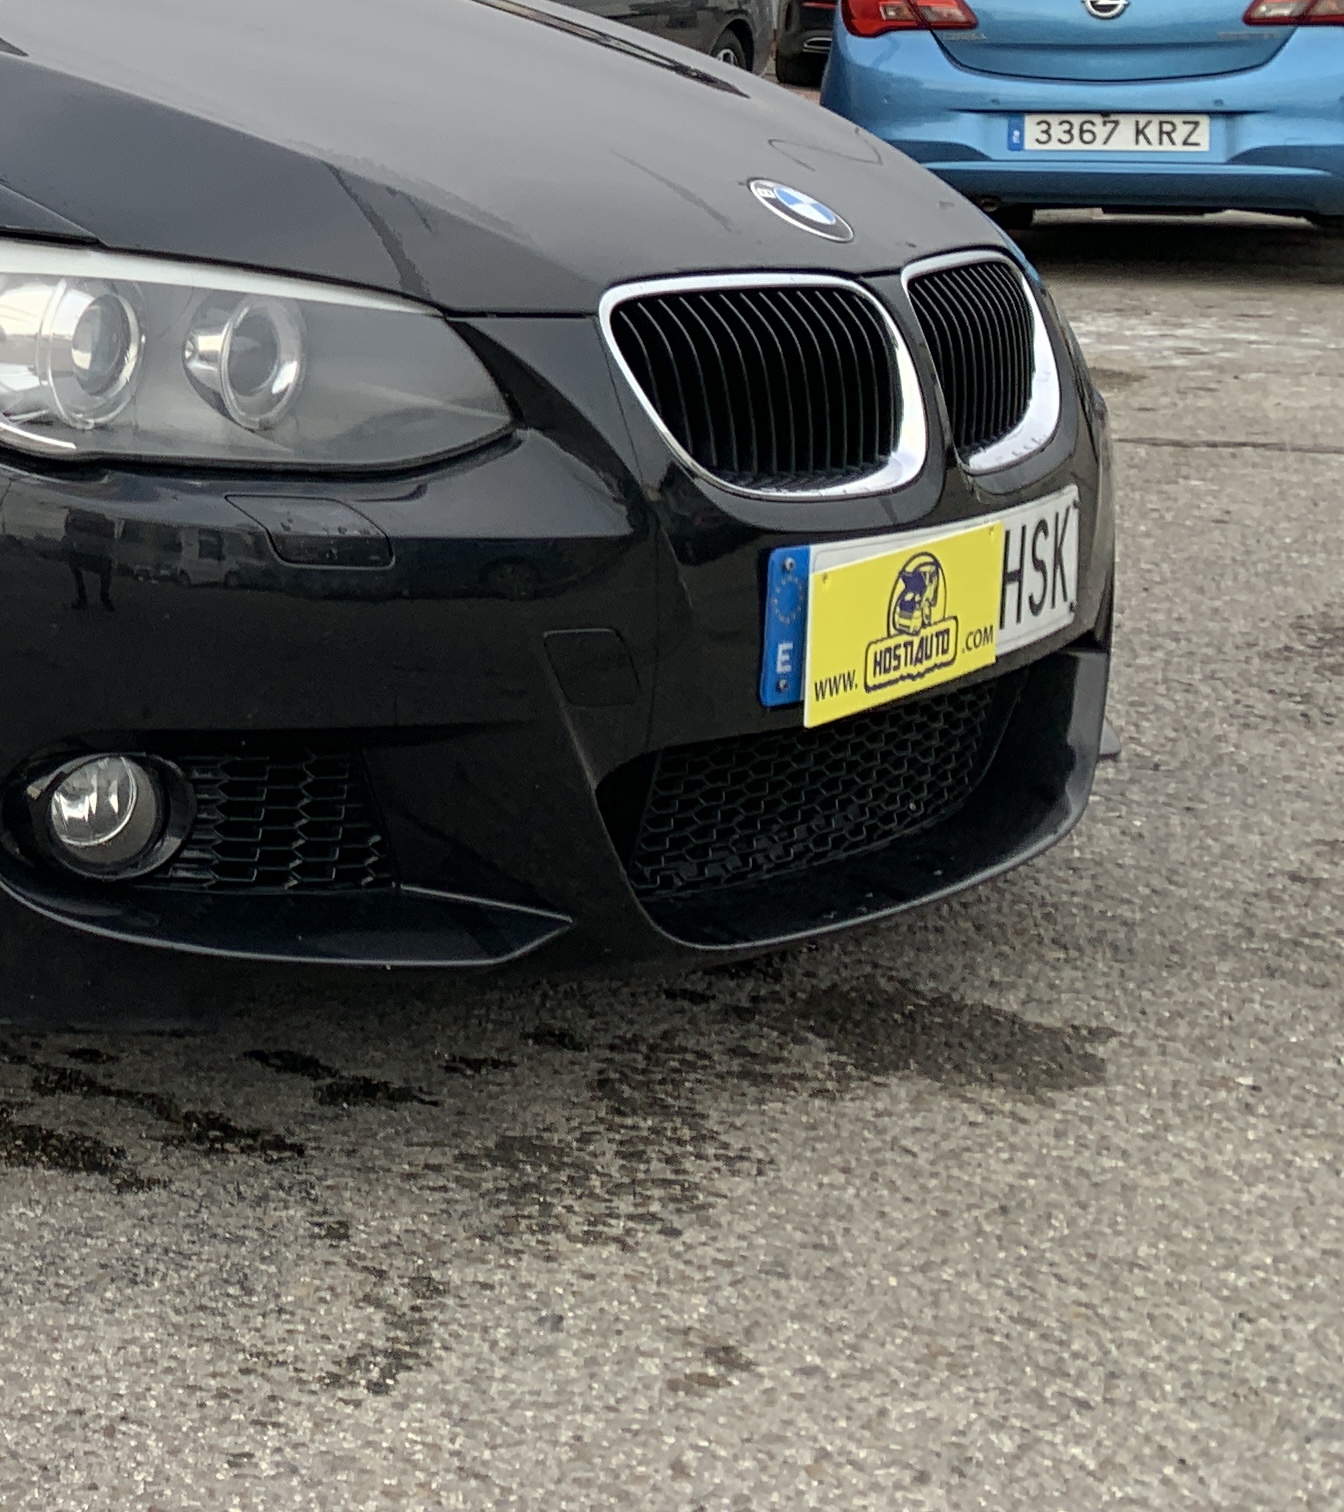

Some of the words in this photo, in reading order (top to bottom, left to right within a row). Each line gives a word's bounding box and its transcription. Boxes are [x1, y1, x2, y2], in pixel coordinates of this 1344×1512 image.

[1034, 119, 1121, 146] 3367
[1134, 120, 1201, 147] KRZ
[999, 506, 1071, 630] HSK
[776, 641, 794, 674] E
[814, 670, 858, 702] WWW.
[873, 629, 951, 678] HOSTIAUTO
